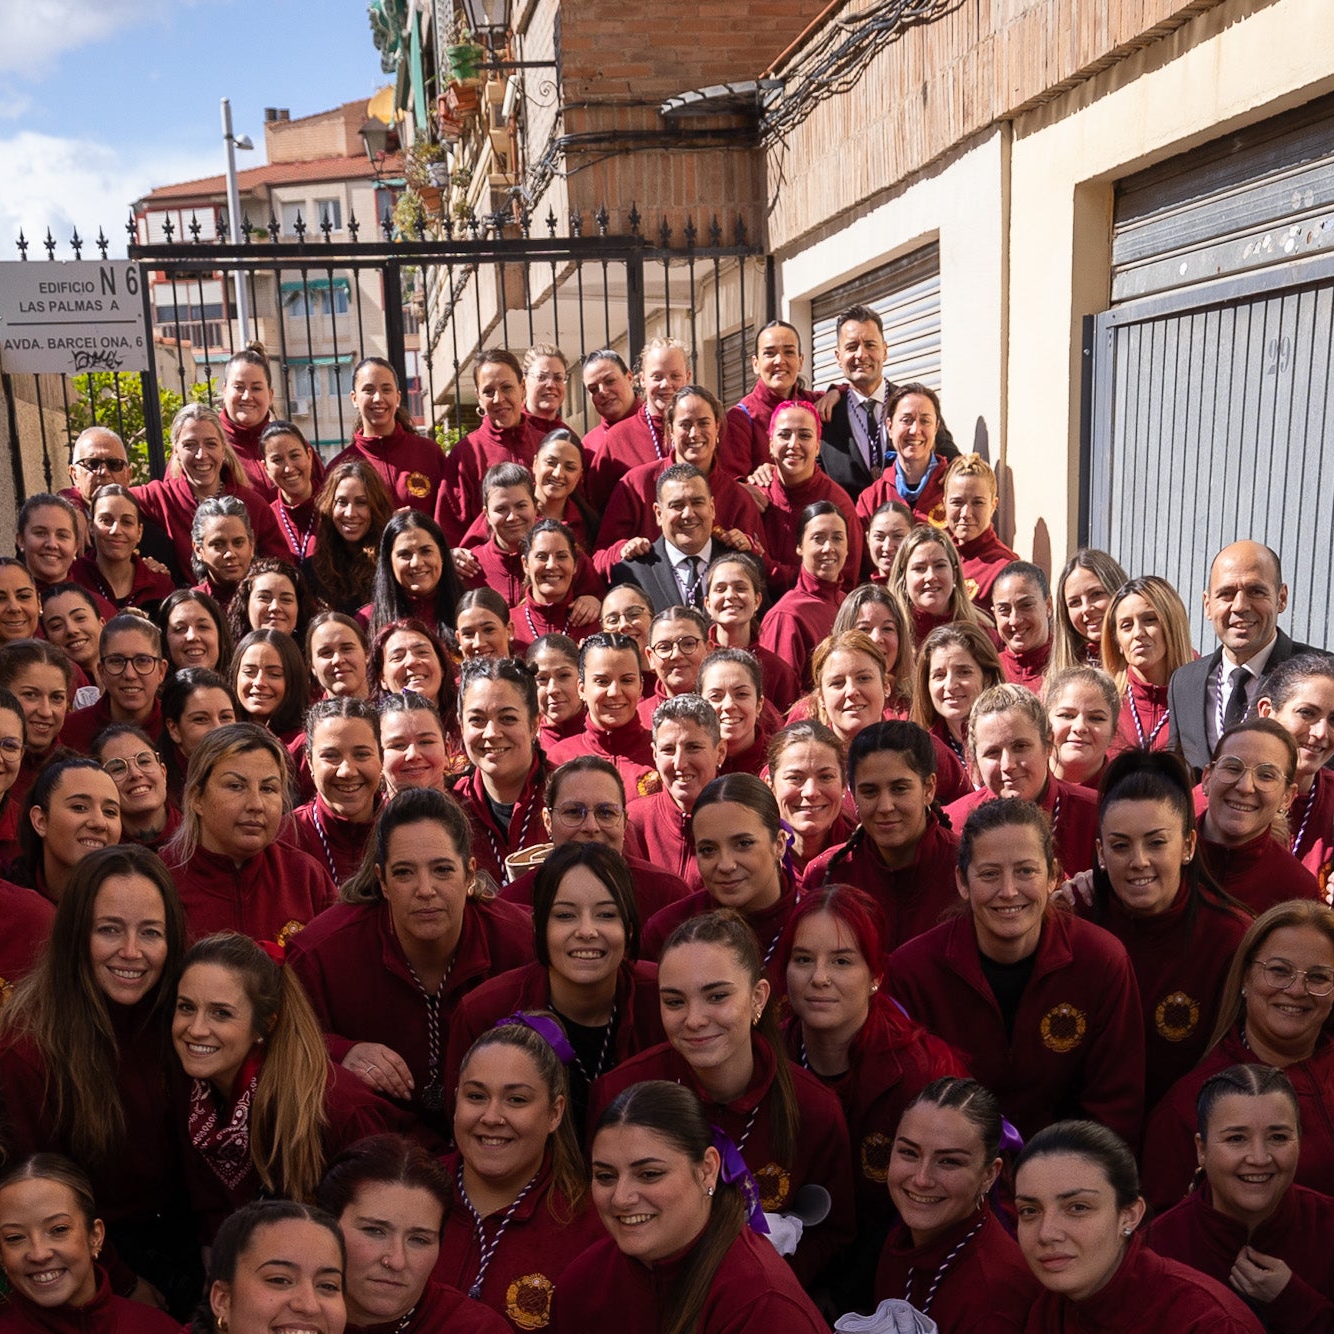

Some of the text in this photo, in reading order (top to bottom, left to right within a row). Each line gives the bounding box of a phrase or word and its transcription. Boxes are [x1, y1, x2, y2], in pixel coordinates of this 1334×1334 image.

[39, 281, 95, 294] EDIFICIO
[99, 266, 139, 296] N 6
[19, 299, 120, 313] LAS PALMAS A
[4, 338, 44, 351] AVDA.
[135, 336, 143, 348] 6
